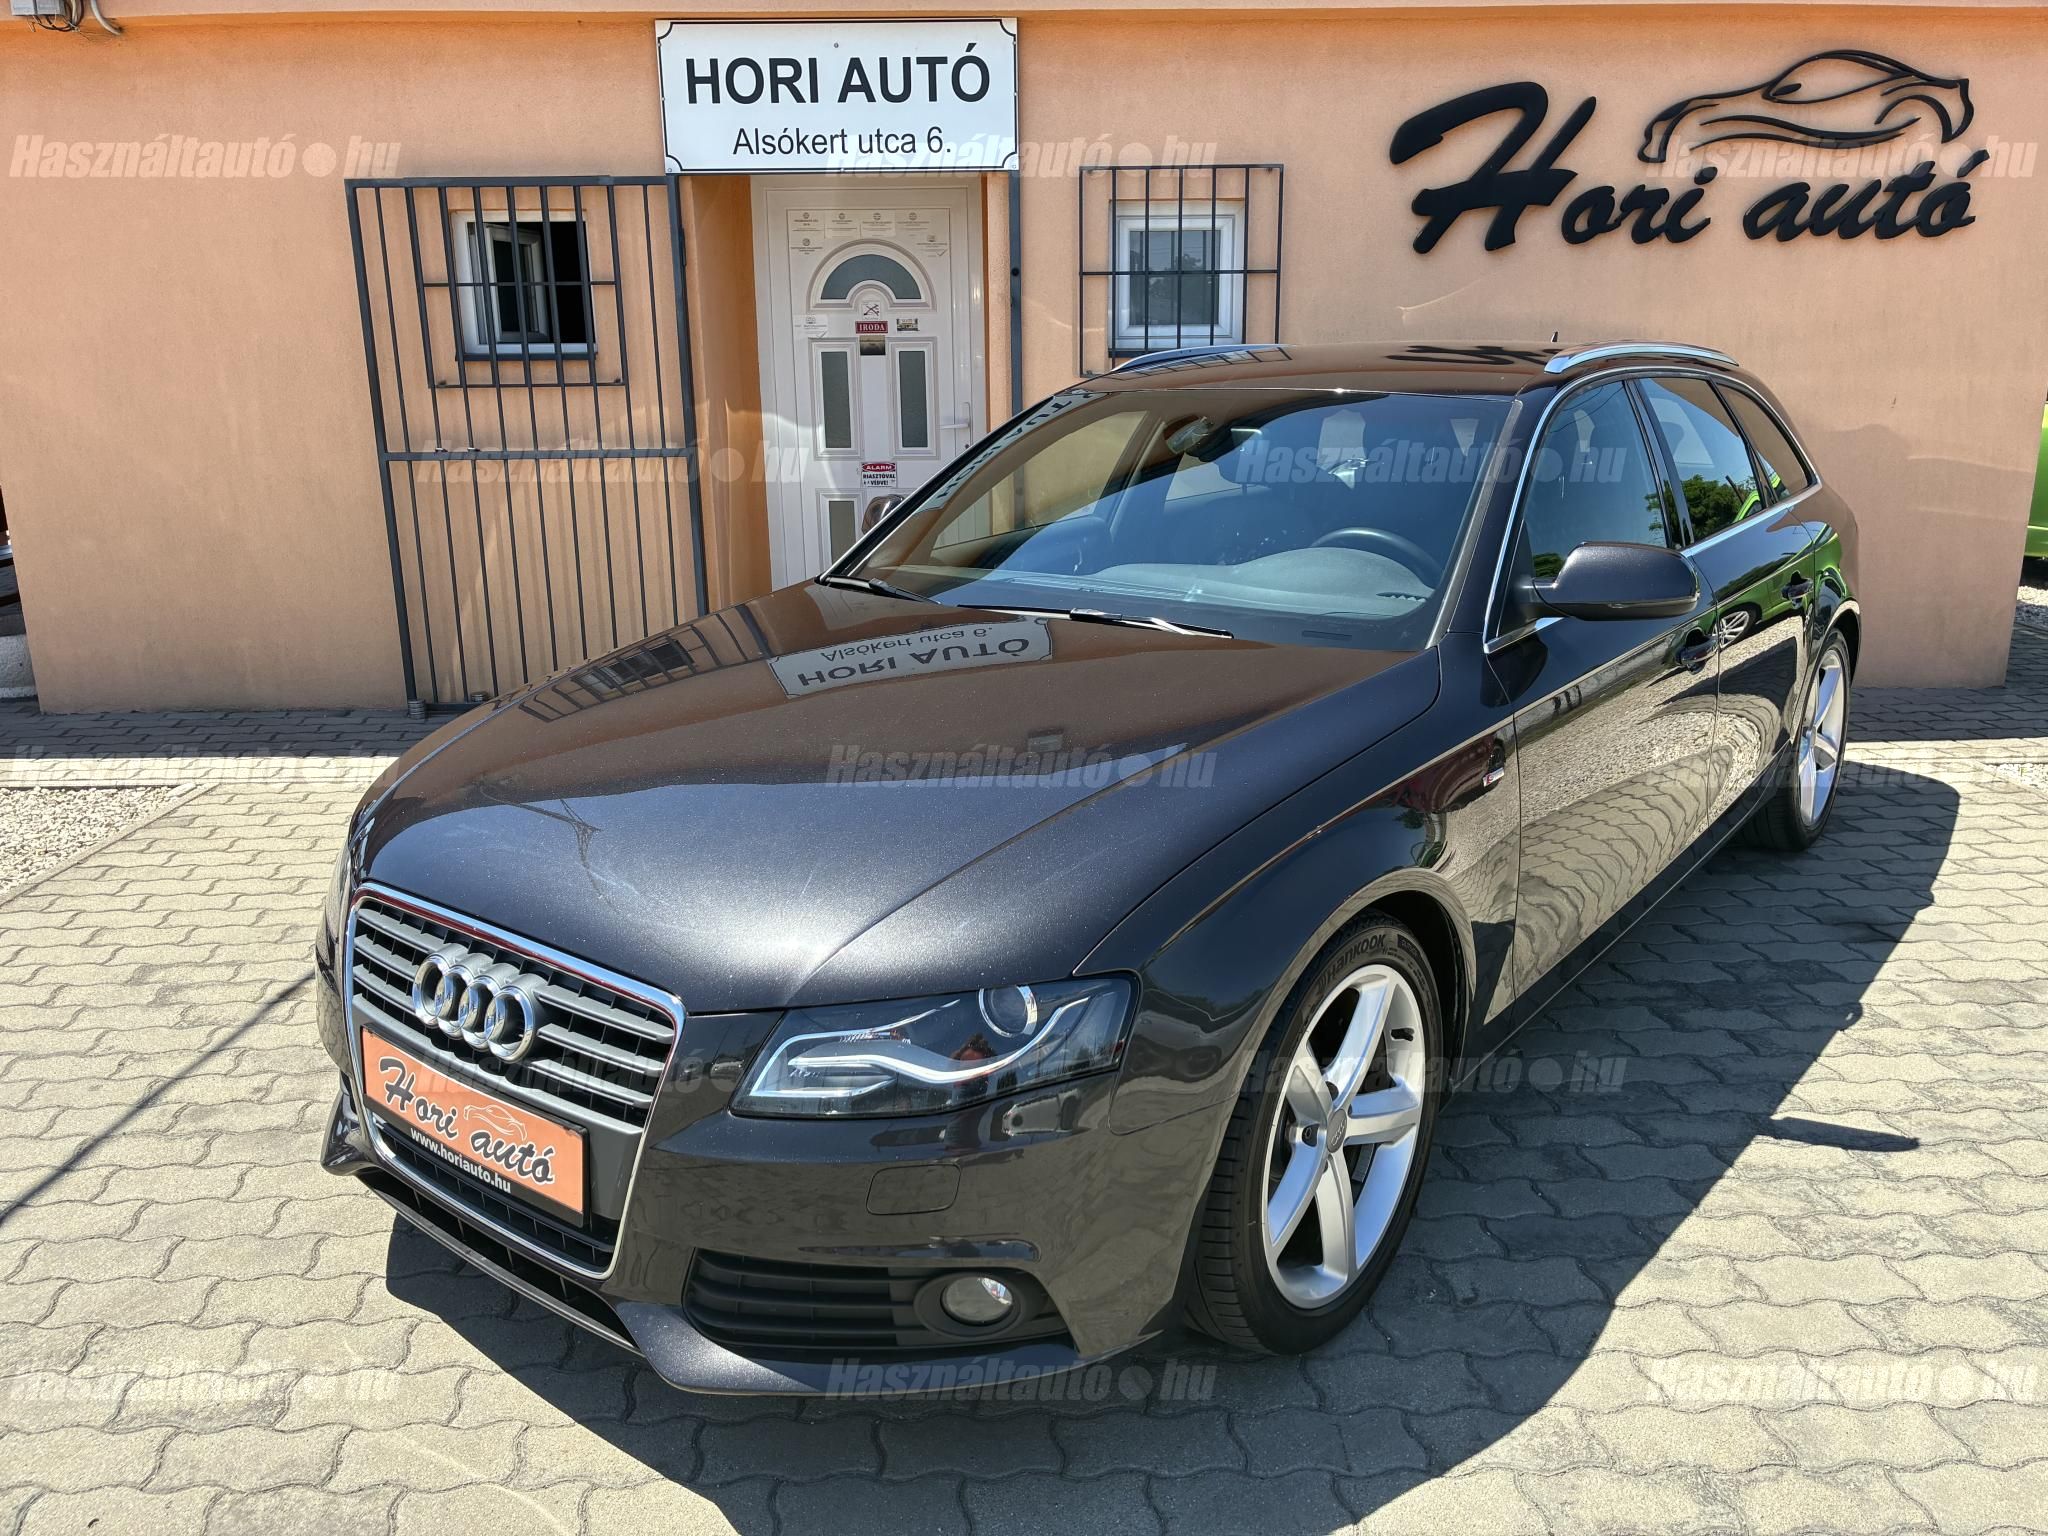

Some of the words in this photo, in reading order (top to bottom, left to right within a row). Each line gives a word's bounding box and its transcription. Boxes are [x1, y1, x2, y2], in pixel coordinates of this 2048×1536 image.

[685, 56, 819, 104] HORI
[837, 43, 990, 103] AUTÓ
[733, 128, 848, 155] Alsókert
[858, 130, 917, 154] utca
[926, 126, 951, 154] 6.
[1389, 81, 1717, 254] Hori
[1743, 150, 1990, 241] autó
[858, 323, 885, 332] IRODA
[379, 1057, 458, 1139] Hori
[470, 1130, 555, 1184] autó
[410, 1127, 511, 1194] www.horiauto.hu
